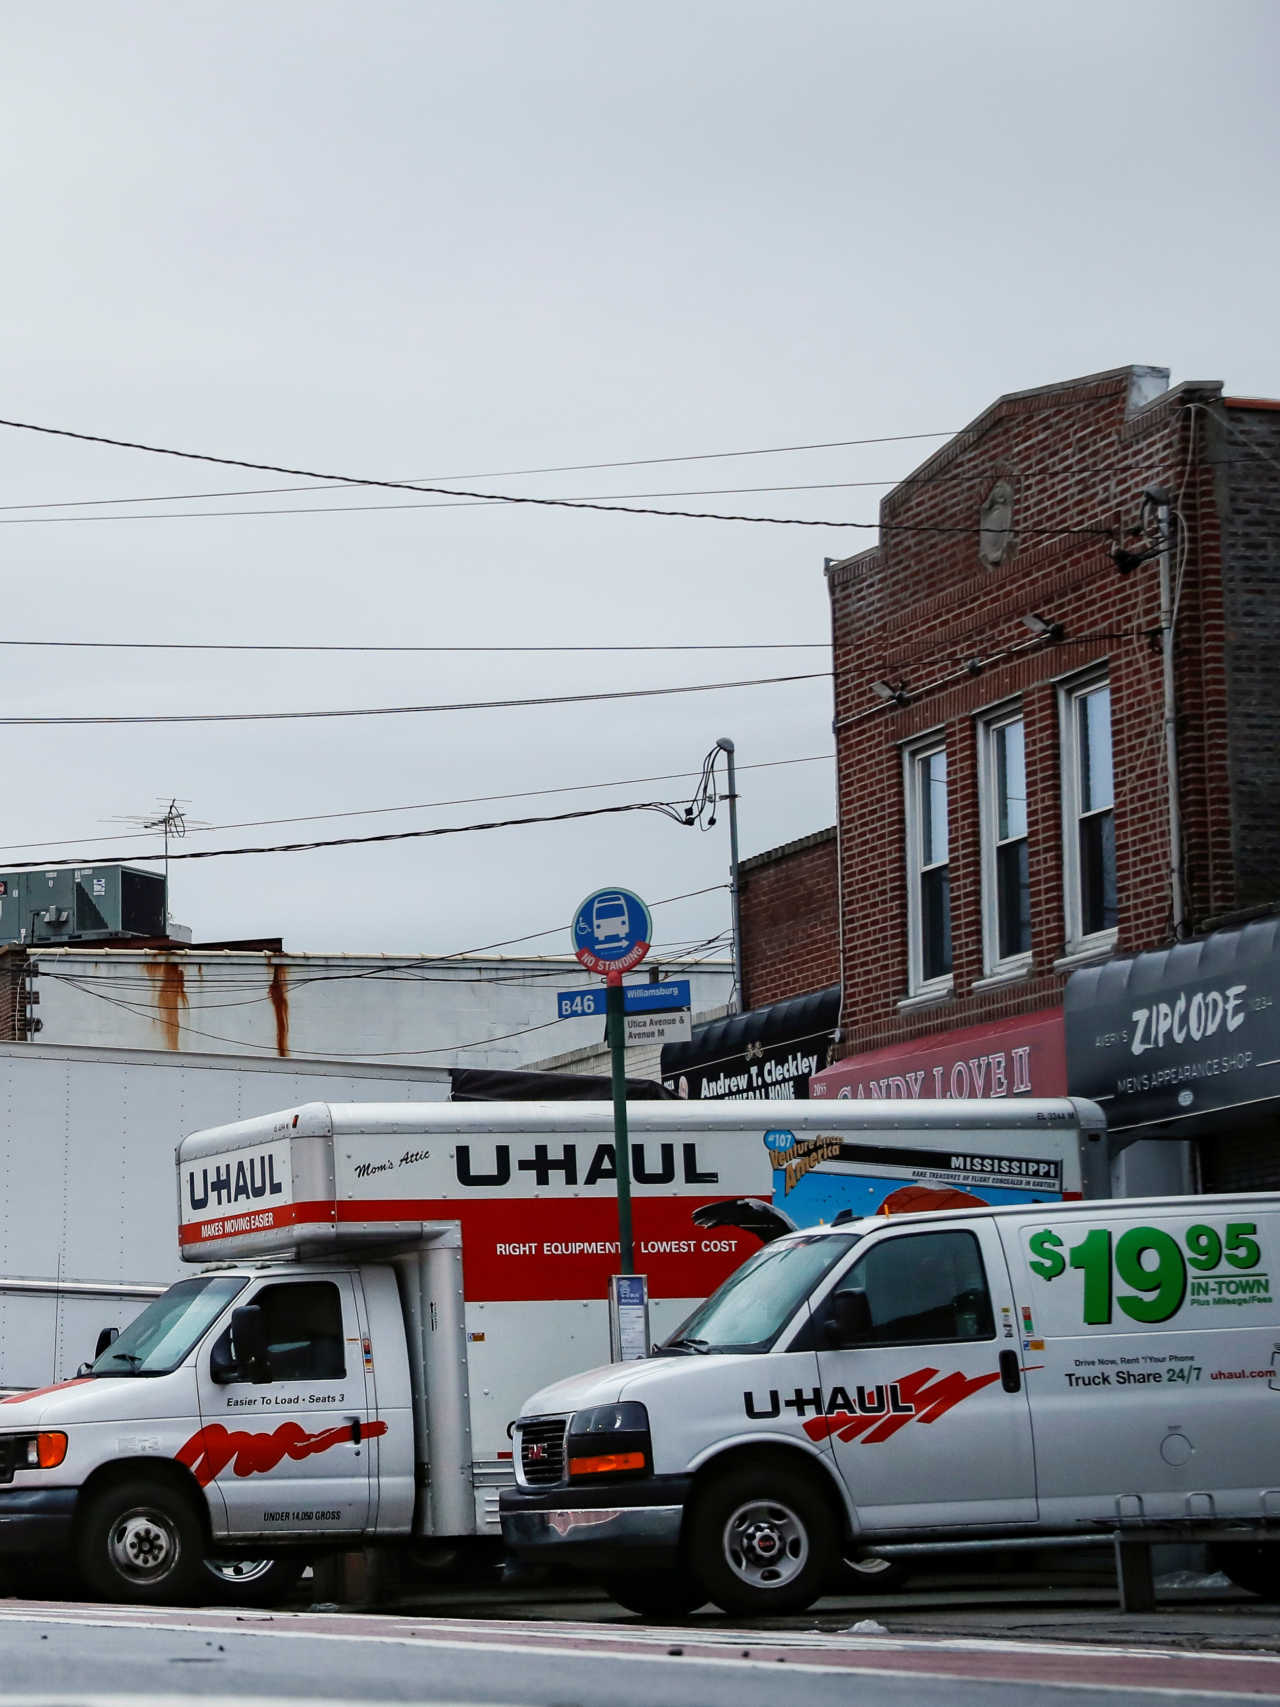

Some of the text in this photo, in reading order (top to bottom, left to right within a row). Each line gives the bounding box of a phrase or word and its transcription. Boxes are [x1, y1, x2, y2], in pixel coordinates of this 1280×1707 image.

[581, 947, 643, 971] NO STANDING
[626, 986, 679, 999] Williamsburg
[561, 995, 595, 1015] B46
[627, 1015, 685, 1029] Utica Avenue &
[1131, 985, 1247, 1055] ZIPCODE
[627, 1028, 665, 1041] Avenue M
[701, 1052, 818, 1099] Andrew T. Cleckley
[933, 1053, 1007, 1100] LOVE
[1012, 1046, 1032, 1093] II
[1151, 1059, 1220, 1085] APPEARANCE
[1222, 1051, 1253, 1073] SHOP
[768, 1080, 795, 1100] HOME
[768, 1134, 792, 1148] #107
[354, 1149, 431, 1179] Mom's Attic
[770, 1139, 815, 1169] Venture
[455, 1143, 719, 1187] U-HAUL
[785, 1145, 841, 1197] America
[951, 1156, 1056, 1177] MISSISSIPPI
[189, 1153, 282, 1211] U-HAUL
[201, 1212, 274, 1238] MAKES MOVING EASIER
[496, 1239, 738, 1255] RIGHT EQUIPMENT LOWEST COST
[1190, 1279, 1269, 1296] IN-TOWN
[1190, 1298, 1210, 1306] Plus
[1074, 1359, 1096, 1367] Drive
[1098, 1358, 1119, 1367] Now,
[1120, 1356, 1140, 1365] Rent
[1168, 1354, 1195, 1362] Phone
[1065, 1365, 1276, 1387] Truck Share 24/7 uhaul.com
[226, 1394, 345, 1407] Easier To Load Seats 3
[743, 1384, 915, 1420] U-HAUL
[264, 1511, 289, 1521] UNDER
[315, 1510, 341, 1521] GROSS
